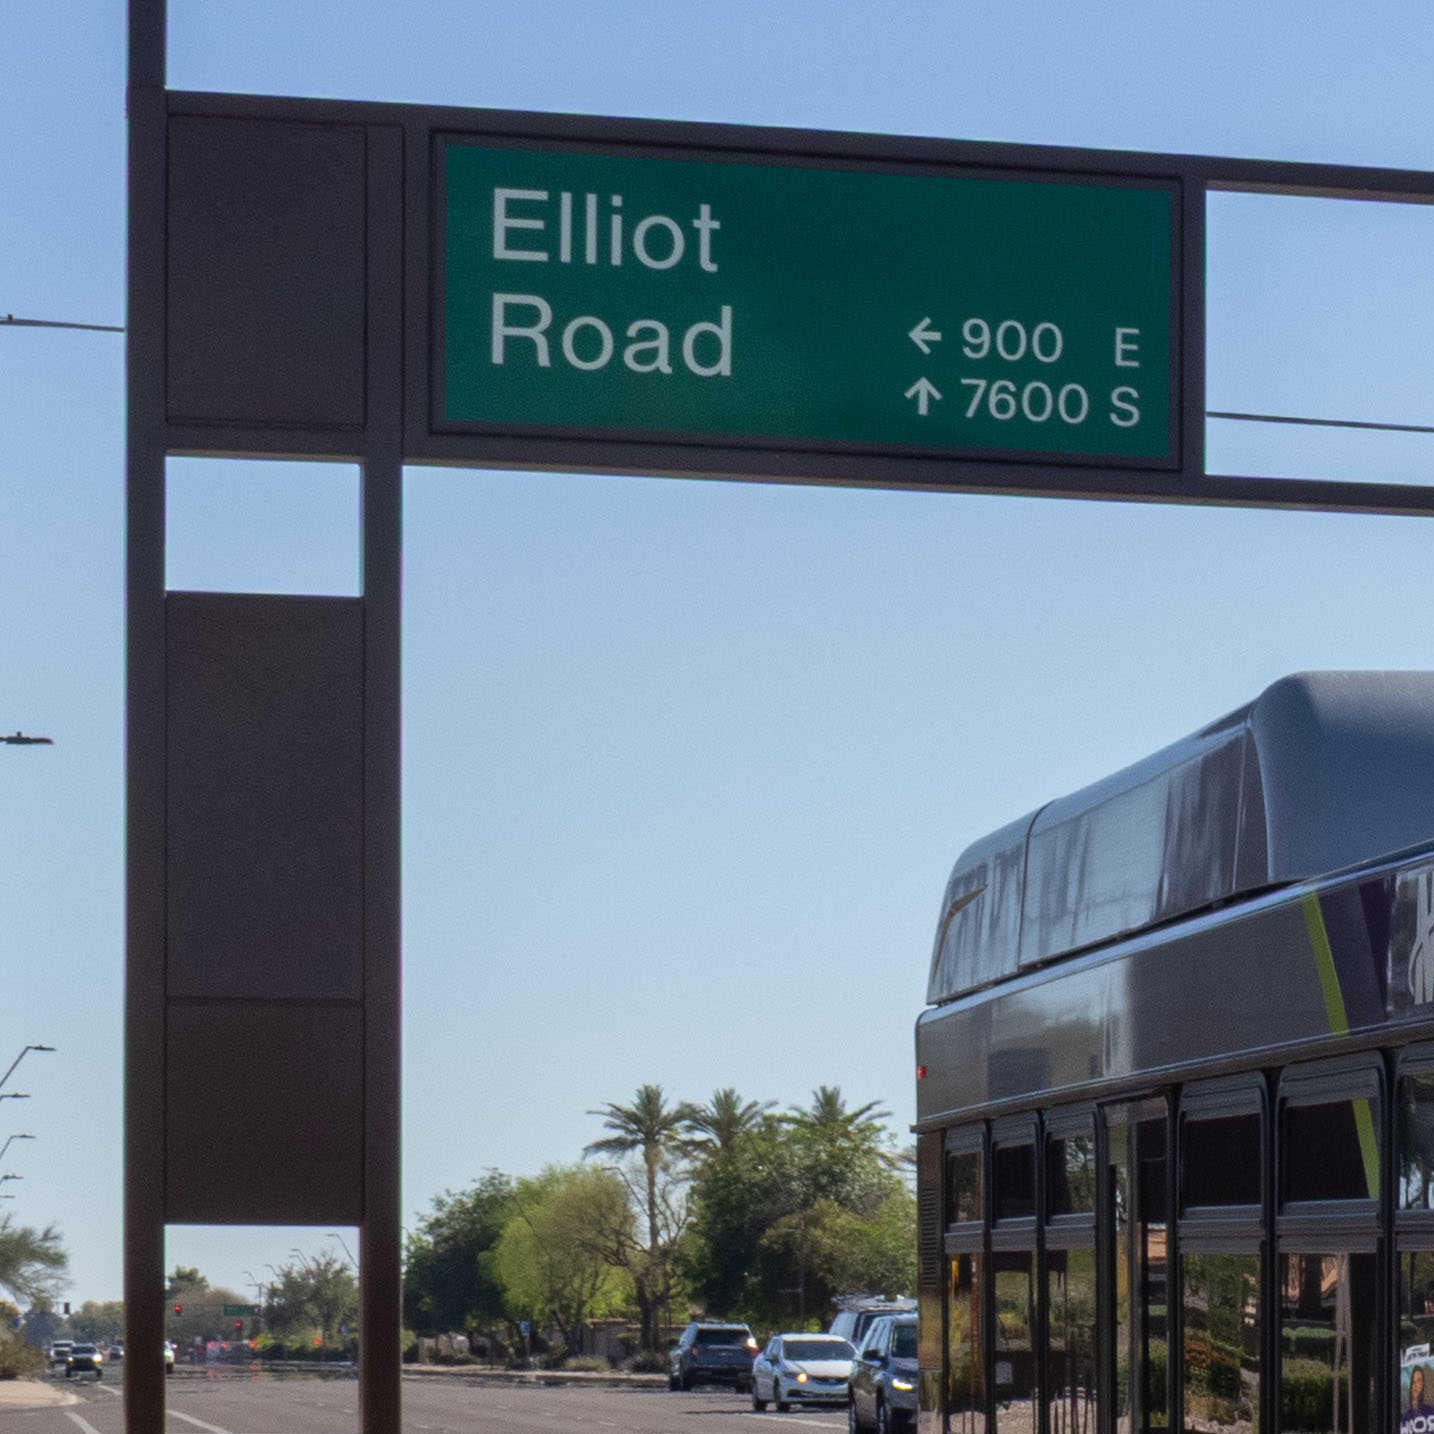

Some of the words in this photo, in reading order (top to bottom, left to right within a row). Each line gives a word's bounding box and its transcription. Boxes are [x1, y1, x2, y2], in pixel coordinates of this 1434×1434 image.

[492, 186, 721, 273] Elliot
[490, 292, 733, 377] Road
[962, 317, 1064, 364] 900
[1114, 326, 1140, 368] E
[960, 378, 1089, 425] 7600
[1109, 385, 1141, 428] S
